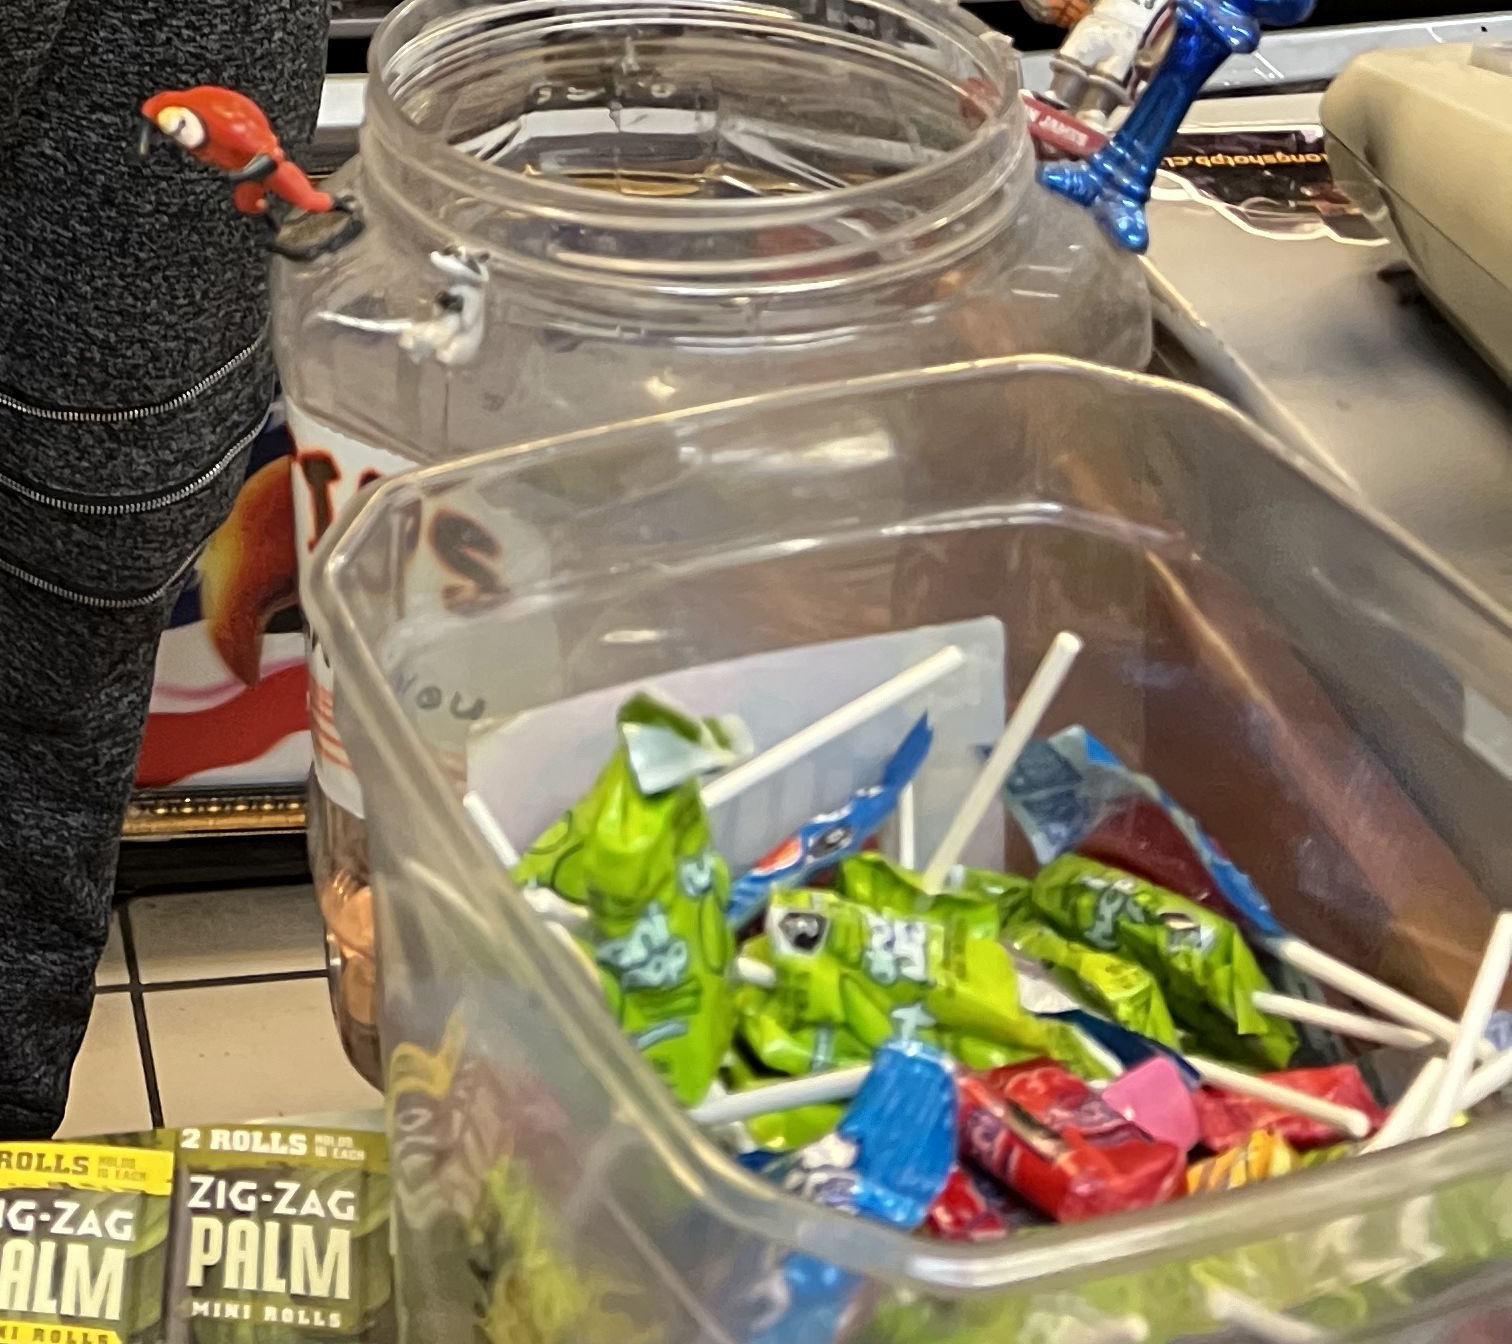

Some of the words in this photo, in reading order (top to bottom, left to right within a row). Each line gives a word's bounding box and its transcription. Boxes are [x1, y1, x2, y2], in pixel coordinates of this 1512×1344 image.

[187, 1175, 356, 1222] ZIG-ZAG
[187, 1216, 354, 1299] PALM
[191, 1299, 256, 1322] MINI
[264, 1305, 342, 1329] ROLLS
